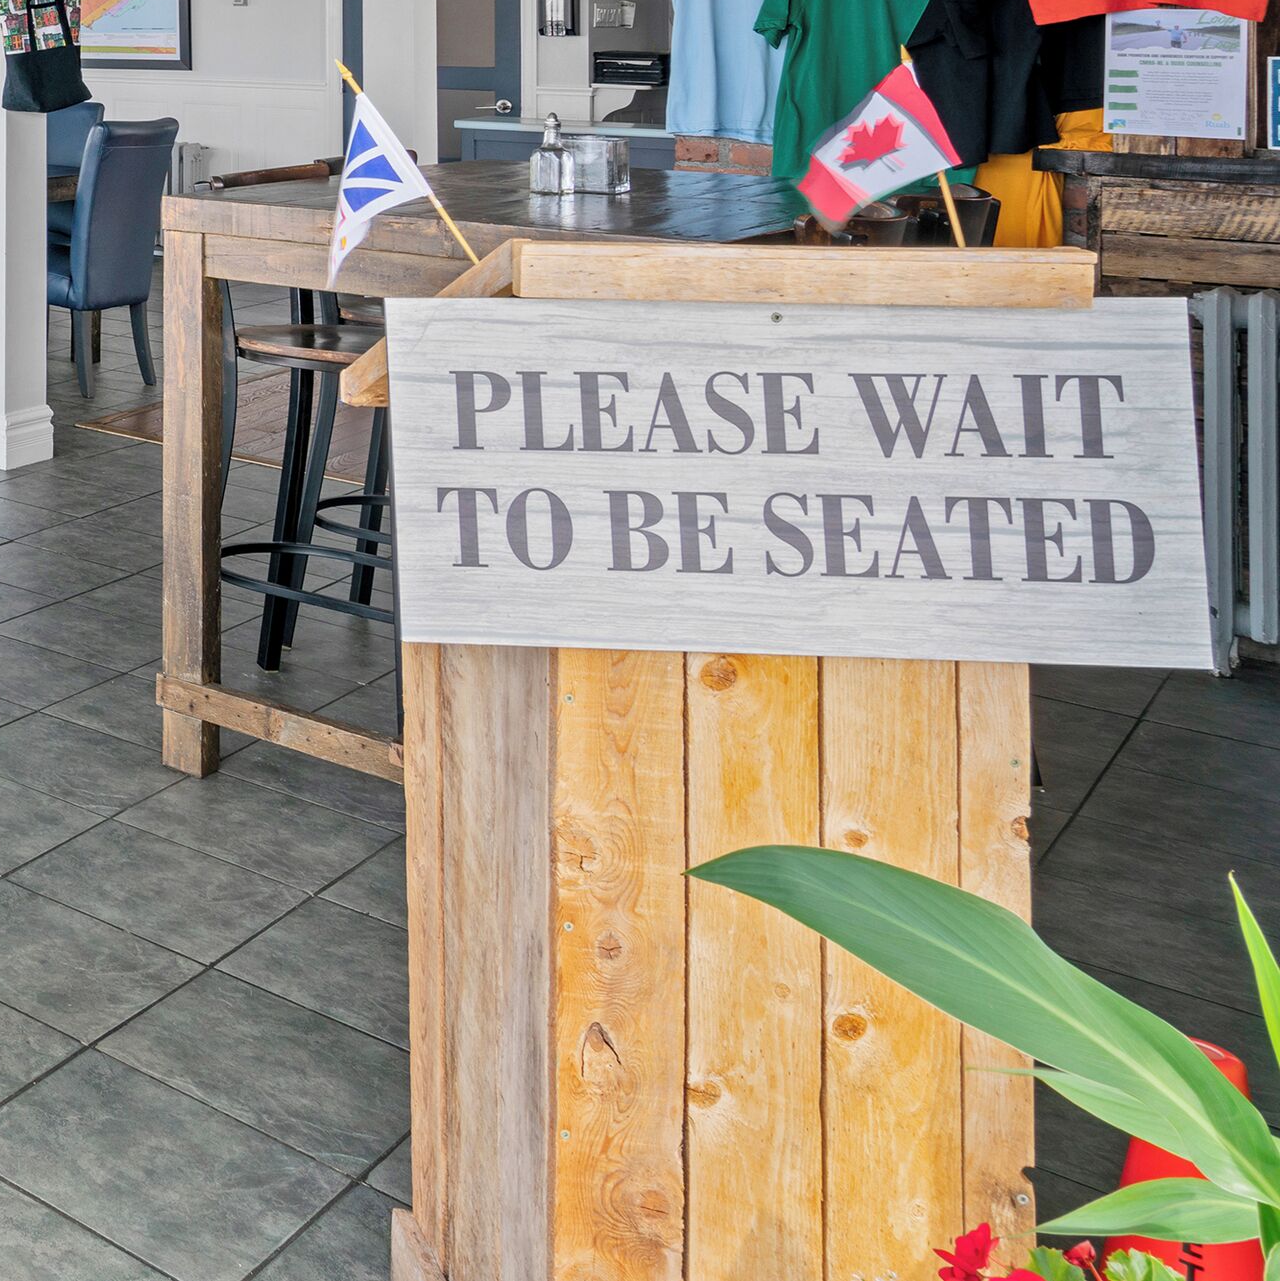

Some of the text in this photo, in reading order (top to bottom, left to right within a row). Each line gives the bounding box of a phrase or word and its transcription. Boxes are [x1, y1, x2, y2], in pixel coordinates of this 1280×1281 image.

[448, 370, 1125, 459] PLEASE WAIT
[436, 486, 1156, 585] TO BE SEATED
